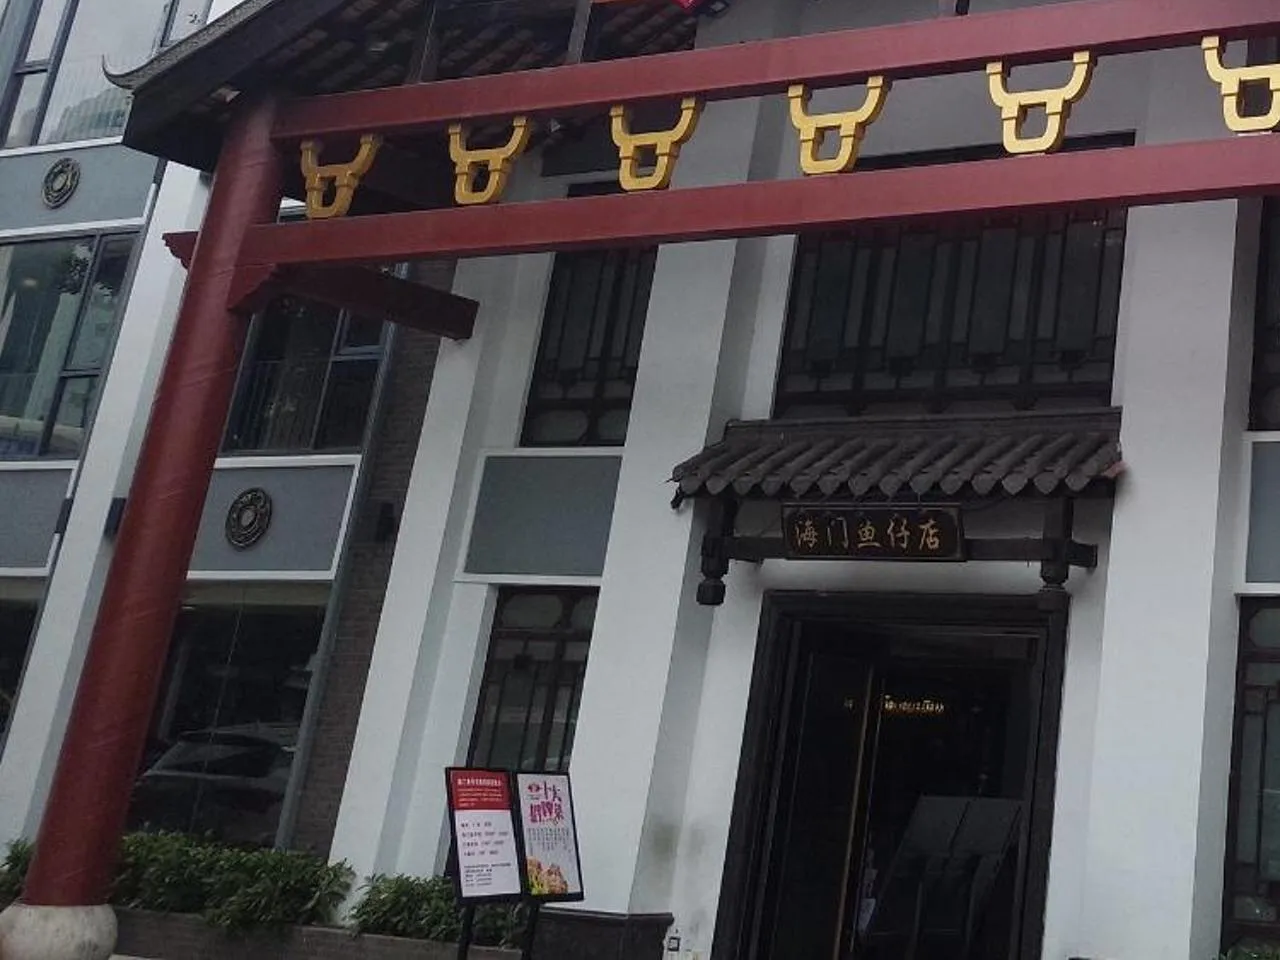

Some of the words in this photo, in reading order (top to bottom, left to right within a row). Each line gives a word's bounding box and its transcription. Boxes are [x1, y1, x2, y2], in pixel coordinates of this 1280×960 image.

[794, 517, 941, 551] 海门鱼仔店
